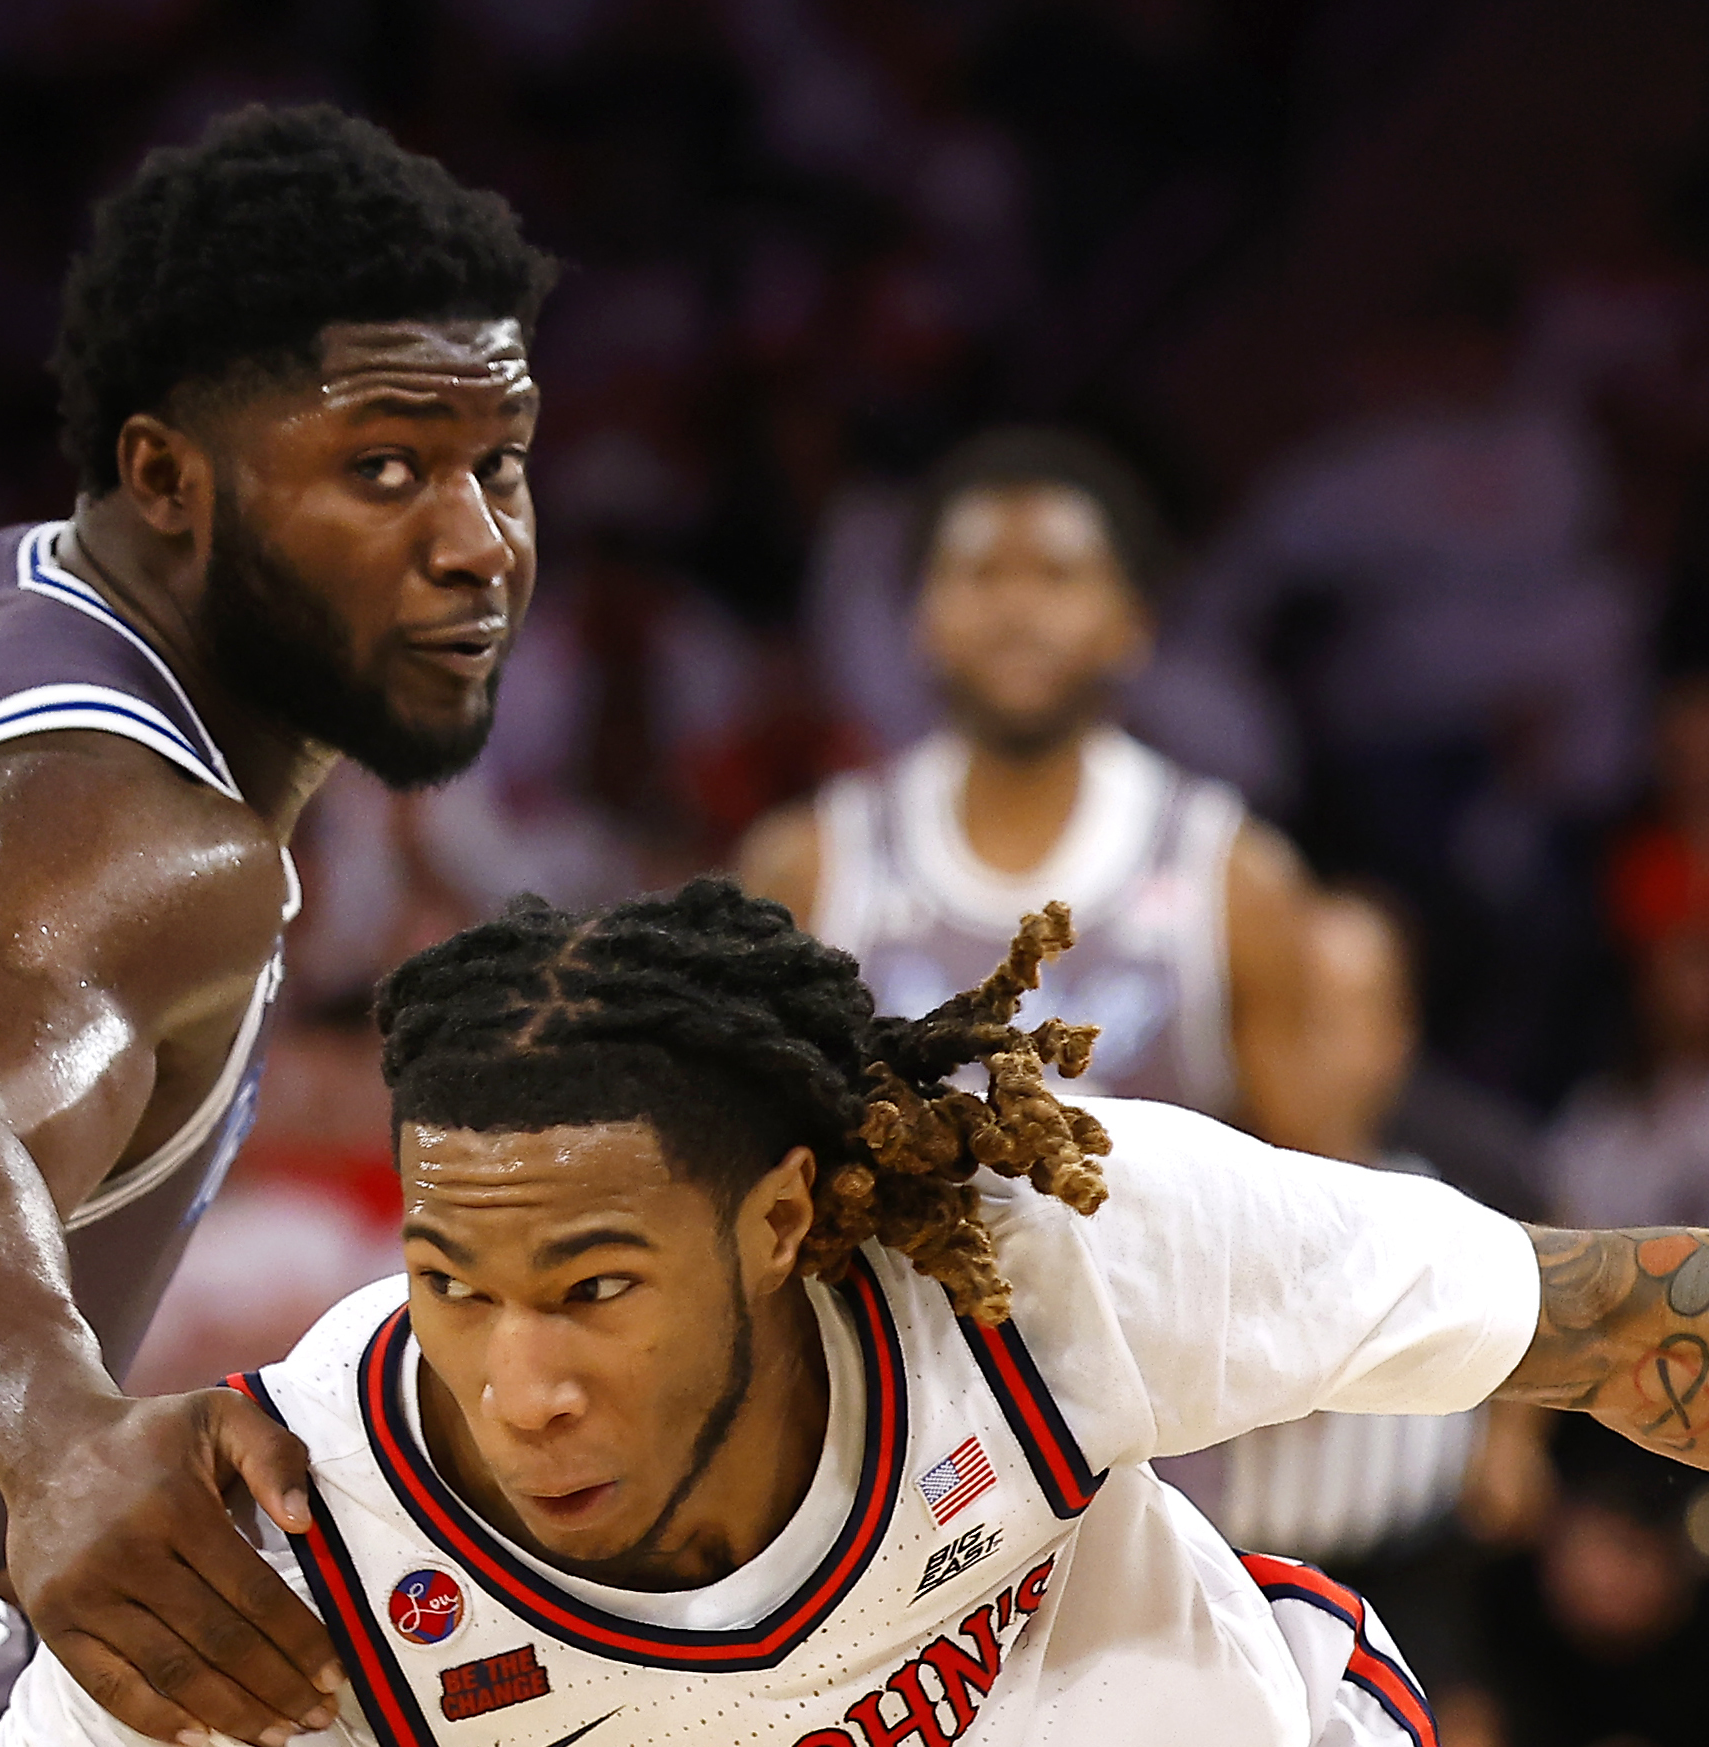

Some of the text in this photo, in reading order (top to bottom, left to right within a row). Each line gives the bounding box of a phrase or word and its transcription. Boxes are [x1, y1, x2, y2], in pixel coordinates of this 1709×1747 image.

[915, 1528, 1004, 1593] EAST
[924, 1523, 985, 1574] BIG
[398, 1582, 459, 1633] Lou
[442, 1668, 549, 1721] CHANGE
[443, 1645, 536, 1694] BE THE
